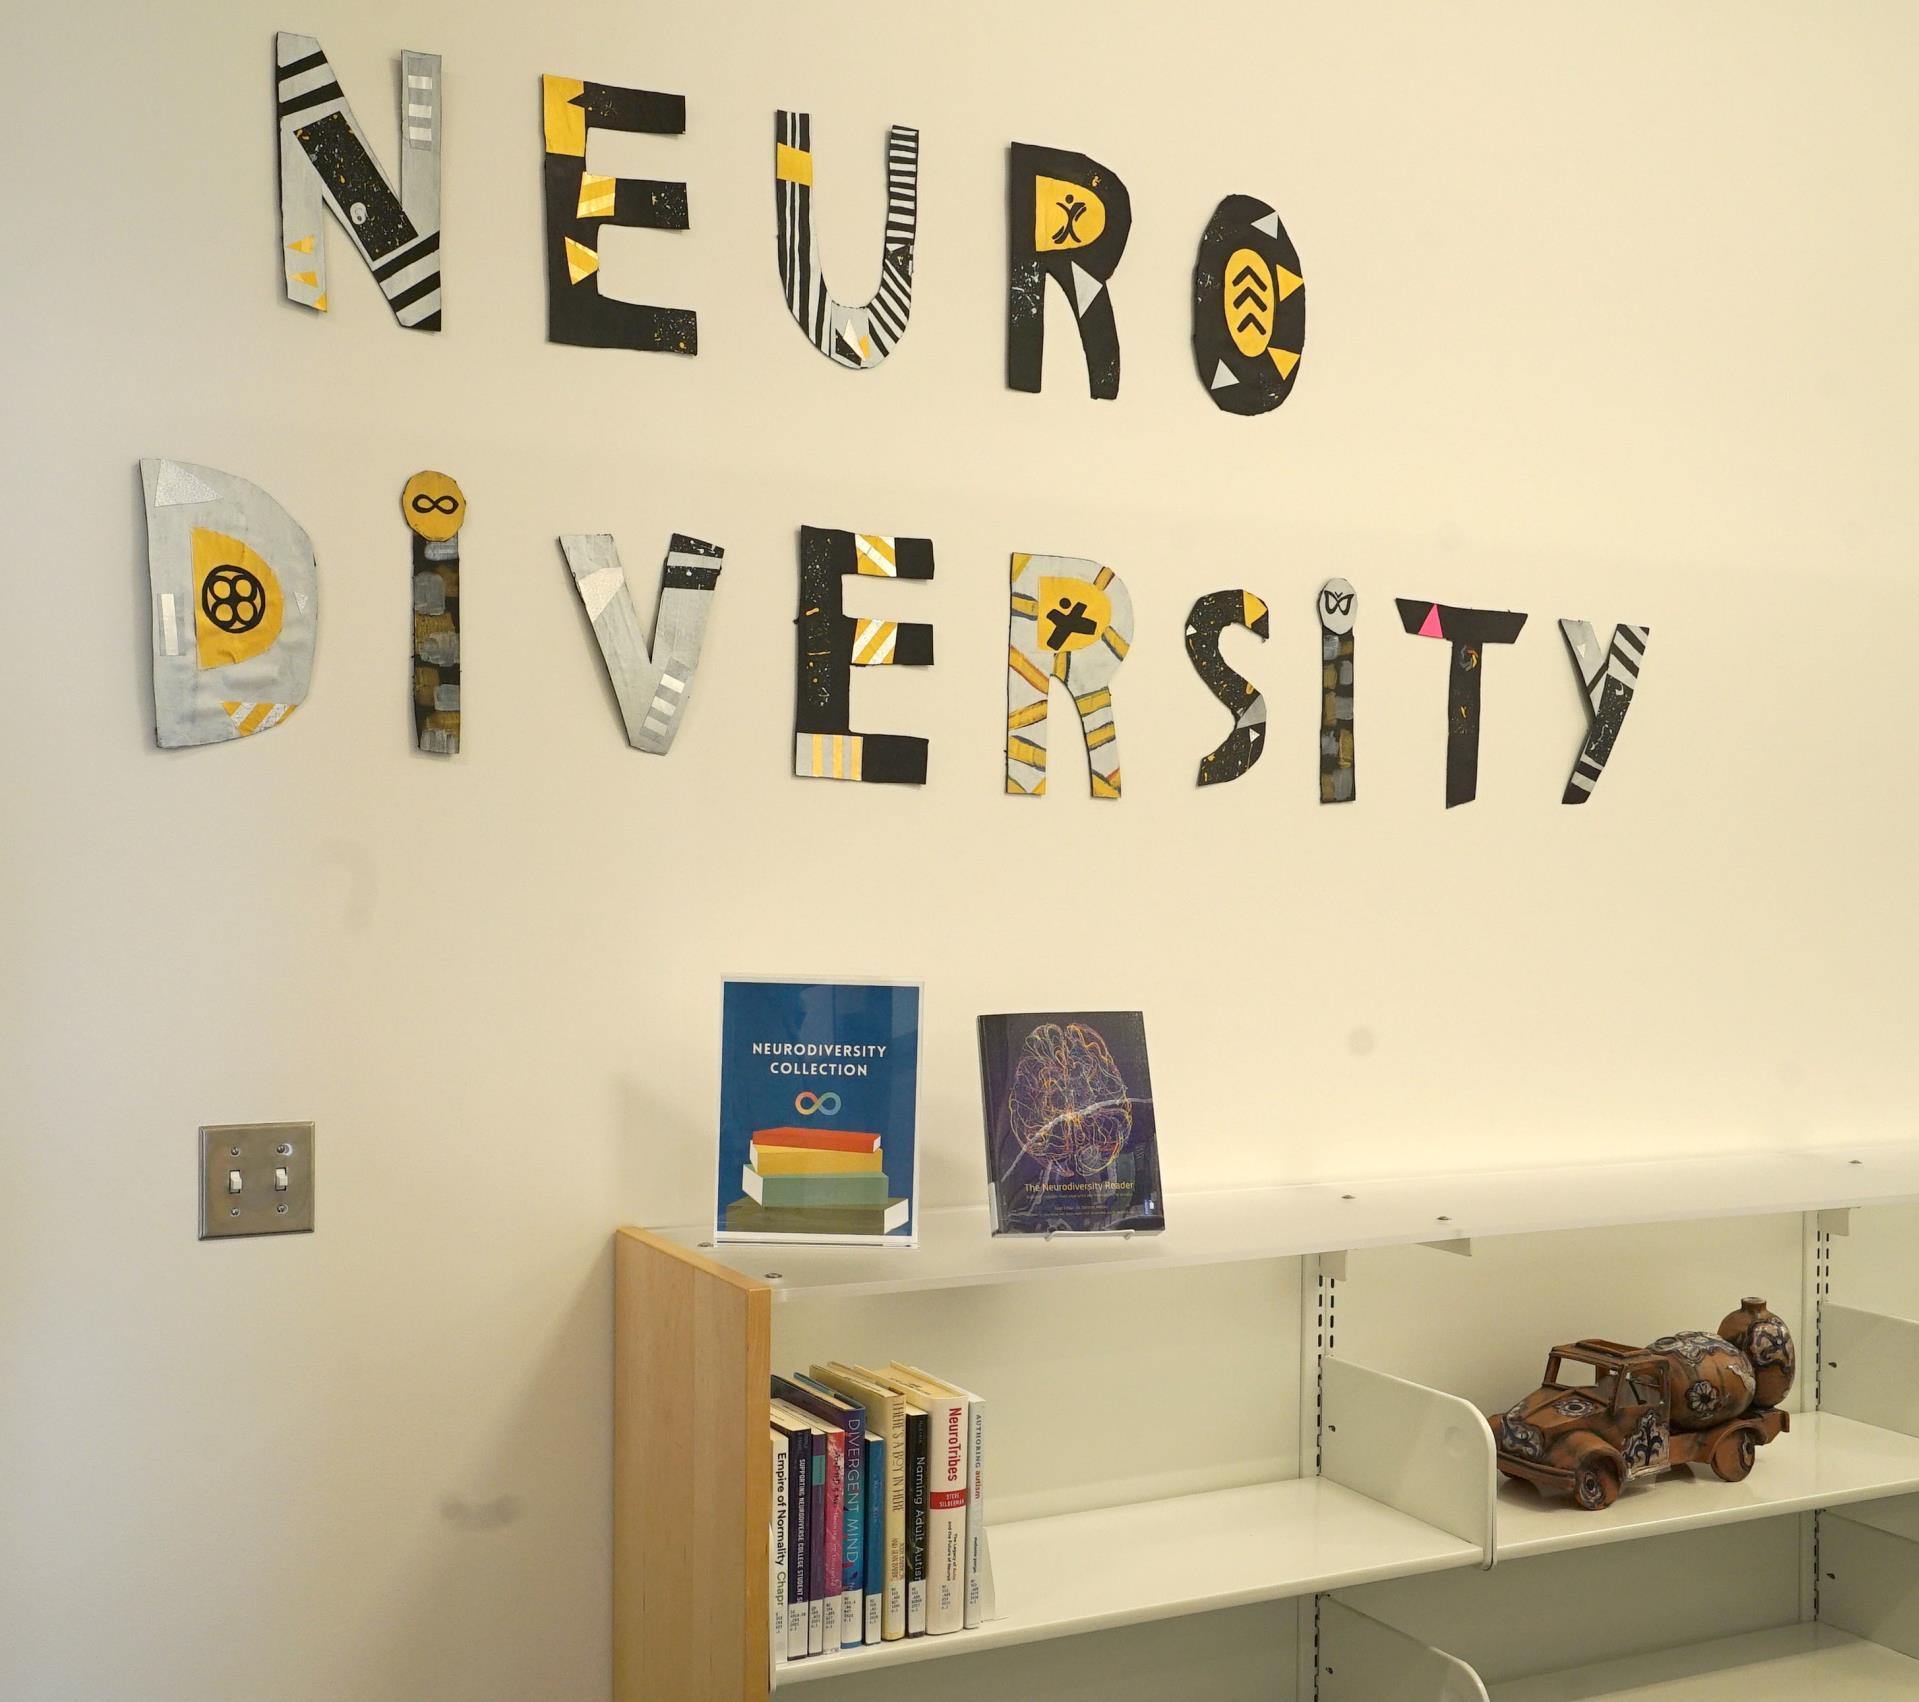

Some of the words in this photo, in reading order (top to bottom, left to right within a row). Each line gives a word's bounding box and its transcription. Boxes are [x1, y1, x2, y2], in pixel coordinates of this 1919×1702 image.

[275, 31, 1306, 416] NEURO
[752, 1042, 887, 1058] NEURODIVERSITY
[770, 1062, 868, 1077] COLLECTION
[1024, 1183, 1040, 1193] The
[1042, 1182, 1103, 1192] Neurodiversity
[1104, 1181, 1135, 1190] Reader
[892, 1401, 905, 1439] THERE'S
[892, 1451, 905, 1472] BOY
[947, 1407, 962, 1482] NeuroTribes
[777, 1452, 787, 1493] Empire
[798, 1458, 806, 1497] SUPPORTING
[847, 1419, 860, 1512] DIVERGENT
[892, 1475, 904, 1487] IN
[914, 1456, 925, 1505] Naming
[777, 1495, 787, 1507] of
[892, 1489, 905, 1512] HERE
[797, 1497, 805, 1542] NEURODIVERSE
[914, 1509, 924, 1540] Adult
[775, 1509, 787, 1566] Normality
[846, 1520, 859, 1563] MIND
[796, 1542, 804, 1568] COLLEGE
[796, 1569, 804, 1596] STUDENT
